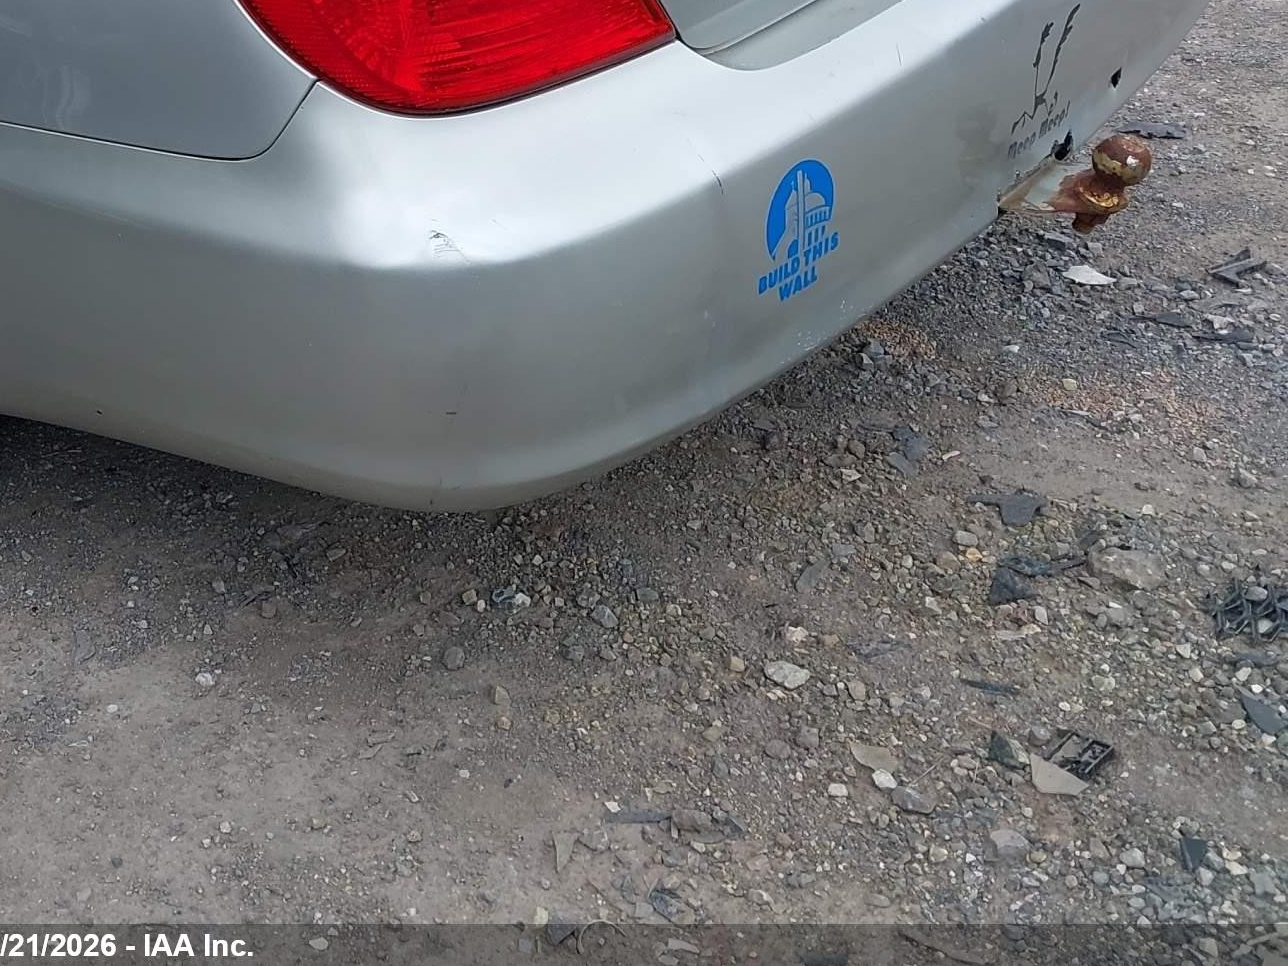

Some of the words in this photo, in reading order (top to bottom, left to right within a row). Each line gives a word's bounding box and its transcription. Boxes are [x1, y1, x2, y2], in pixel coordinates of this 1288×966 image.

[758, 256, 800, 295] BUILD
[804, 232, 839, 266] THIS
[779, 265, 817, 301] WALL
